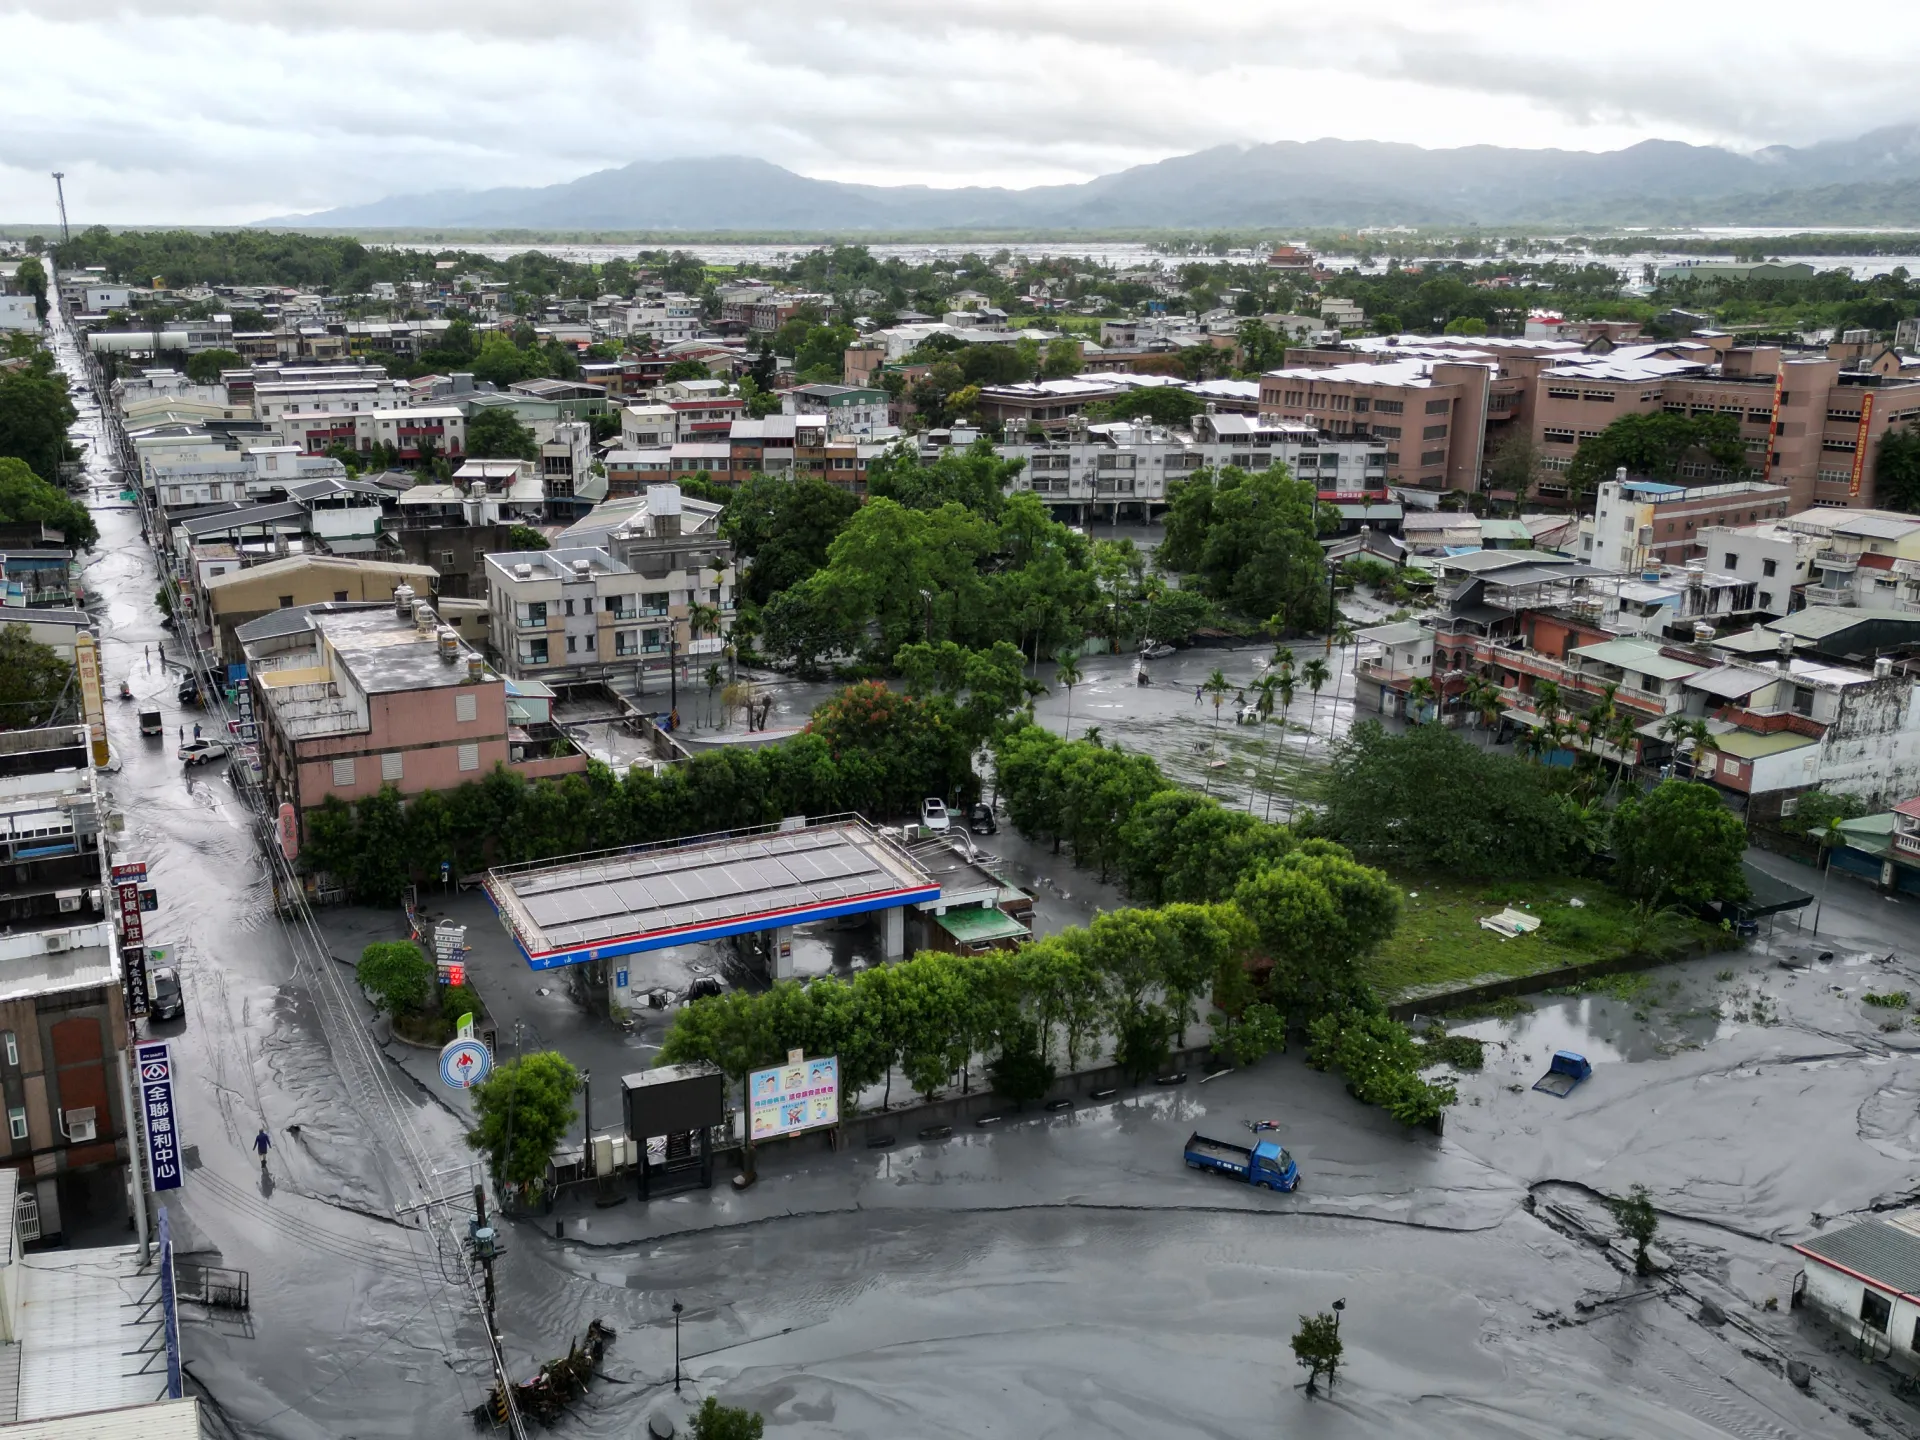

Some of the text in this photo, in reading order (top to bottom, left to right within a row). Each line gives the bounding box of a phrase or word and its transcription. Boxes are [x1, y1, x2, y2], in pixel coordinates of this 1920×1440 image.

[119, 865, 140, 875] 24H
[122, 887, 140, 940] 花東鴨莊
[147, 1086, 176, 1178] 全聯福利中心
